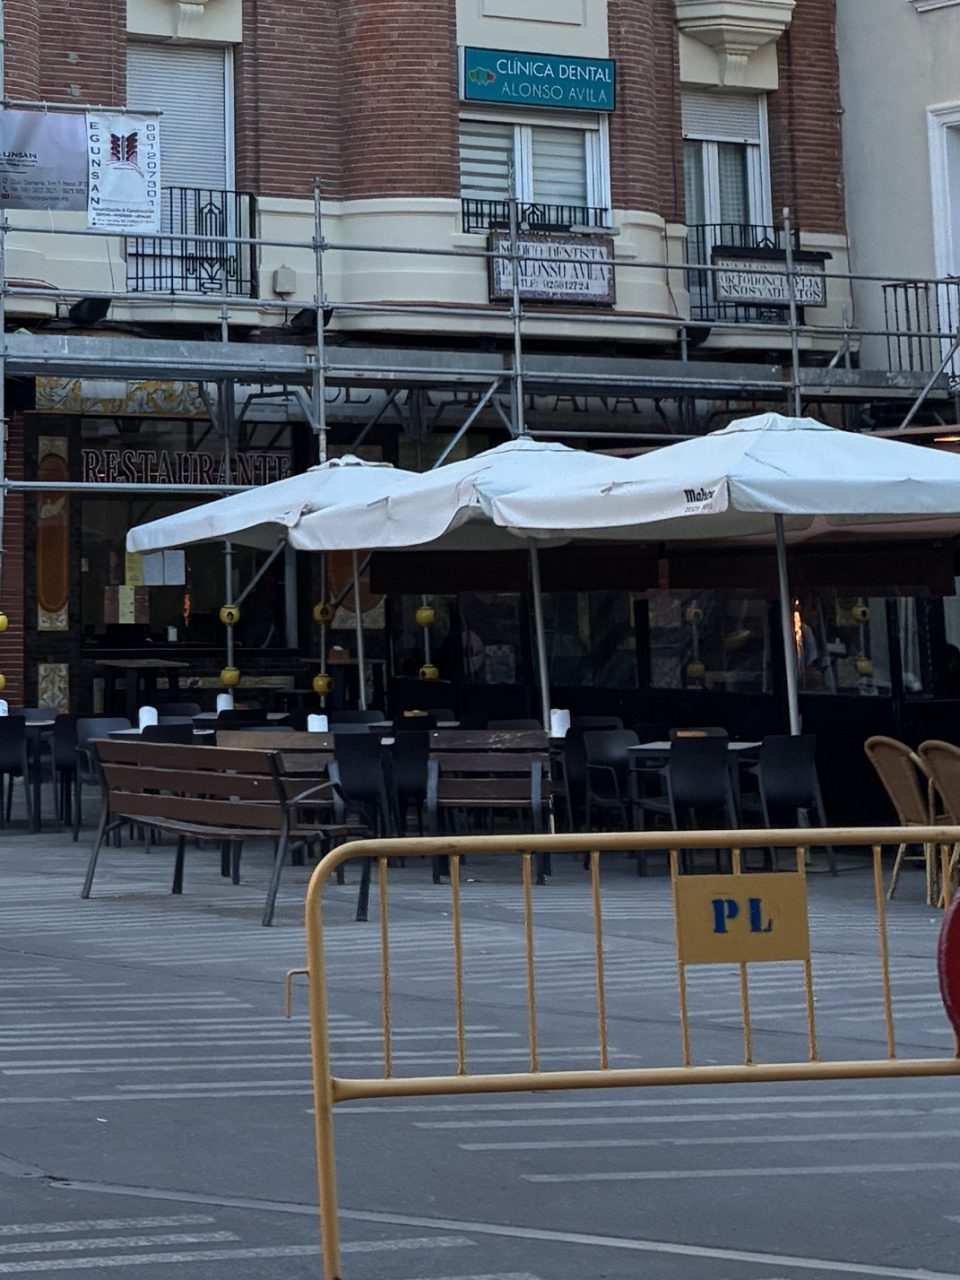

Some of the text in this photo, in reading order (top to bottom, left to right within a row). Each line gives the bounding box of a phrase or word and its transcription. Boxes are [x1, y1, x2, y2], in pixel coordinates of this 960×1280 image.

[496, 57, 611, 82] CLÍNICA DENTAL
[501, 82, 607, 103] ALONSO AVILA
[89, 122, 101, 205] EGUNSAN
[518, 260, 566, 279] ALONSO
[720, 272, 792, 287] ORTODONCI
[767, 288, 821, 299] ADUTOS
[82, 449, 291, 486] RESTAURANTE
